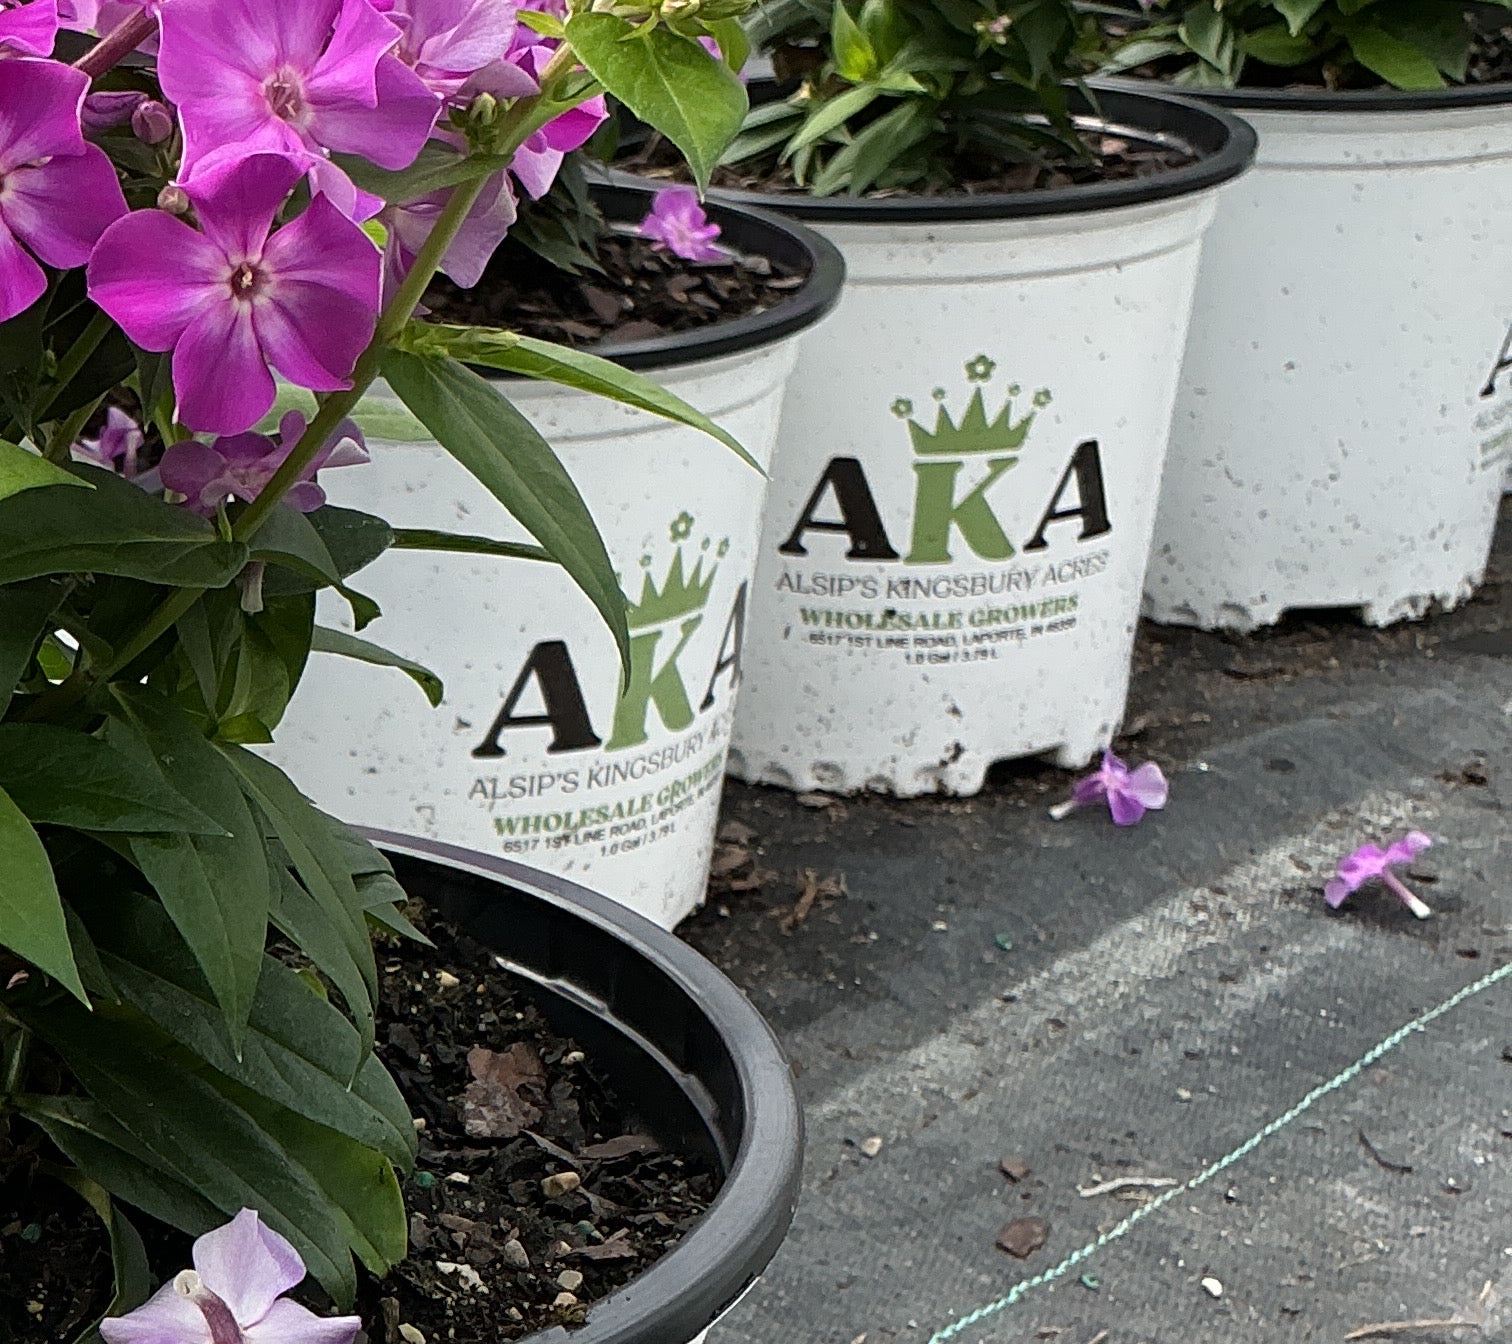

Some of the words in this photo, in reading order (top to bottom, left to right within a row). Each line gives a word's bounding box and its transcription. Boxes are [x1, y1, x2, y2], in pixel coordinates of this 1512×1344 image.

[777, 439, 1112, 564] AKA
[776, 572, 878, 600] ALSIP'S
[886, 567, 1038, 600] KINGSBURY
[799, 606, 963, 631] WHOLESALE
[968, 594, 1079, 628] GROWERS
[471, 579, 748, 759] AKA
[467, 770, 579, 801] ALSIP'S
[587, 732, 704, 790] KINGSBURY
[493, 793, 654, 837] WHOLESALE
